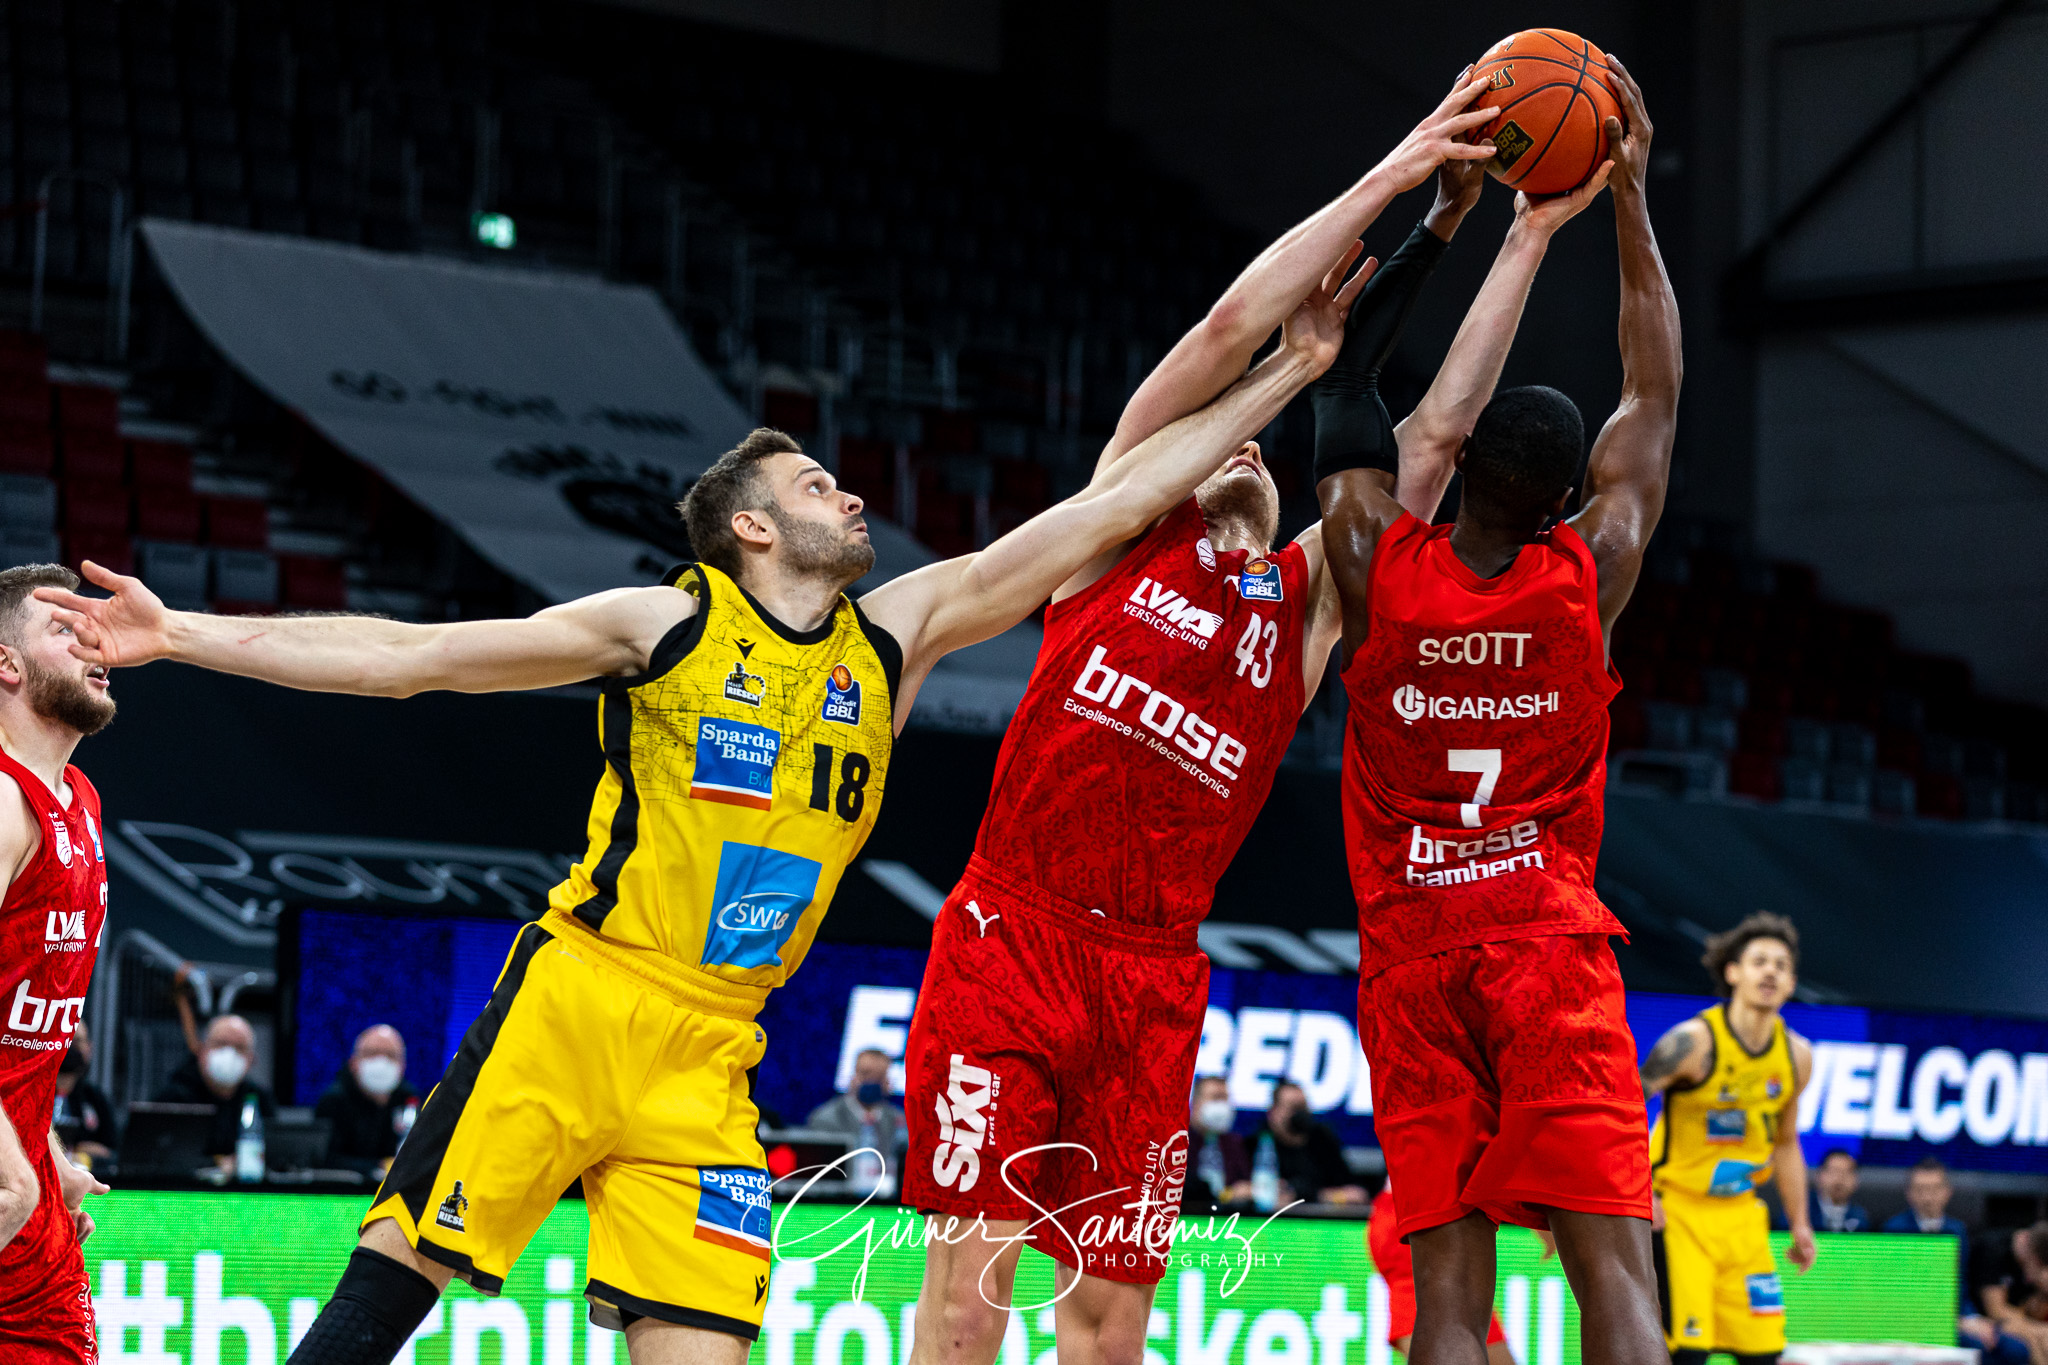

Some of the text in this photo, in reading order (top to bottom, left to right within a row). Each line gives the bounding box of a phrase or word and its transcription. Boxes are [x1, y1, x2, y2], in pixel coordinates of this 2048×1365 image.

[1245, 585, 1278, 597] BBL
[1122, 602, 1208, 651] VERSICHEUNG
[1235, 611, 1278, 689] 43
[1418, 632, 1532, 668] SCOTT
[726, 686, 759, 702] RIESEN
[1428, 691, 1559, 720] IGARASHI
[825, 704, 856, 720] BBL
[1072, 644, 1247, 781] brose
[701, 723, 778, 751] Sparda
[1063, 697, 1231, 799] Excellence in Mechatronics
[721, 743, 774, 767] Bank
[748, 770, 771, 788] BW
[809, 742, 871, 823] 18
[1447, 748, 1502, 829] 7
[1408, 820, 1539, 864] brose
[8, 978, 86, 1034] bro
[0, 1034, 63, 1051] Excellence
[991, 1073, 1001, 1097] car
[990, 1102, 998, 1111] a
[438, 1210, 464, 1227] RIESE
[758, 1217, 770, 1234] B
